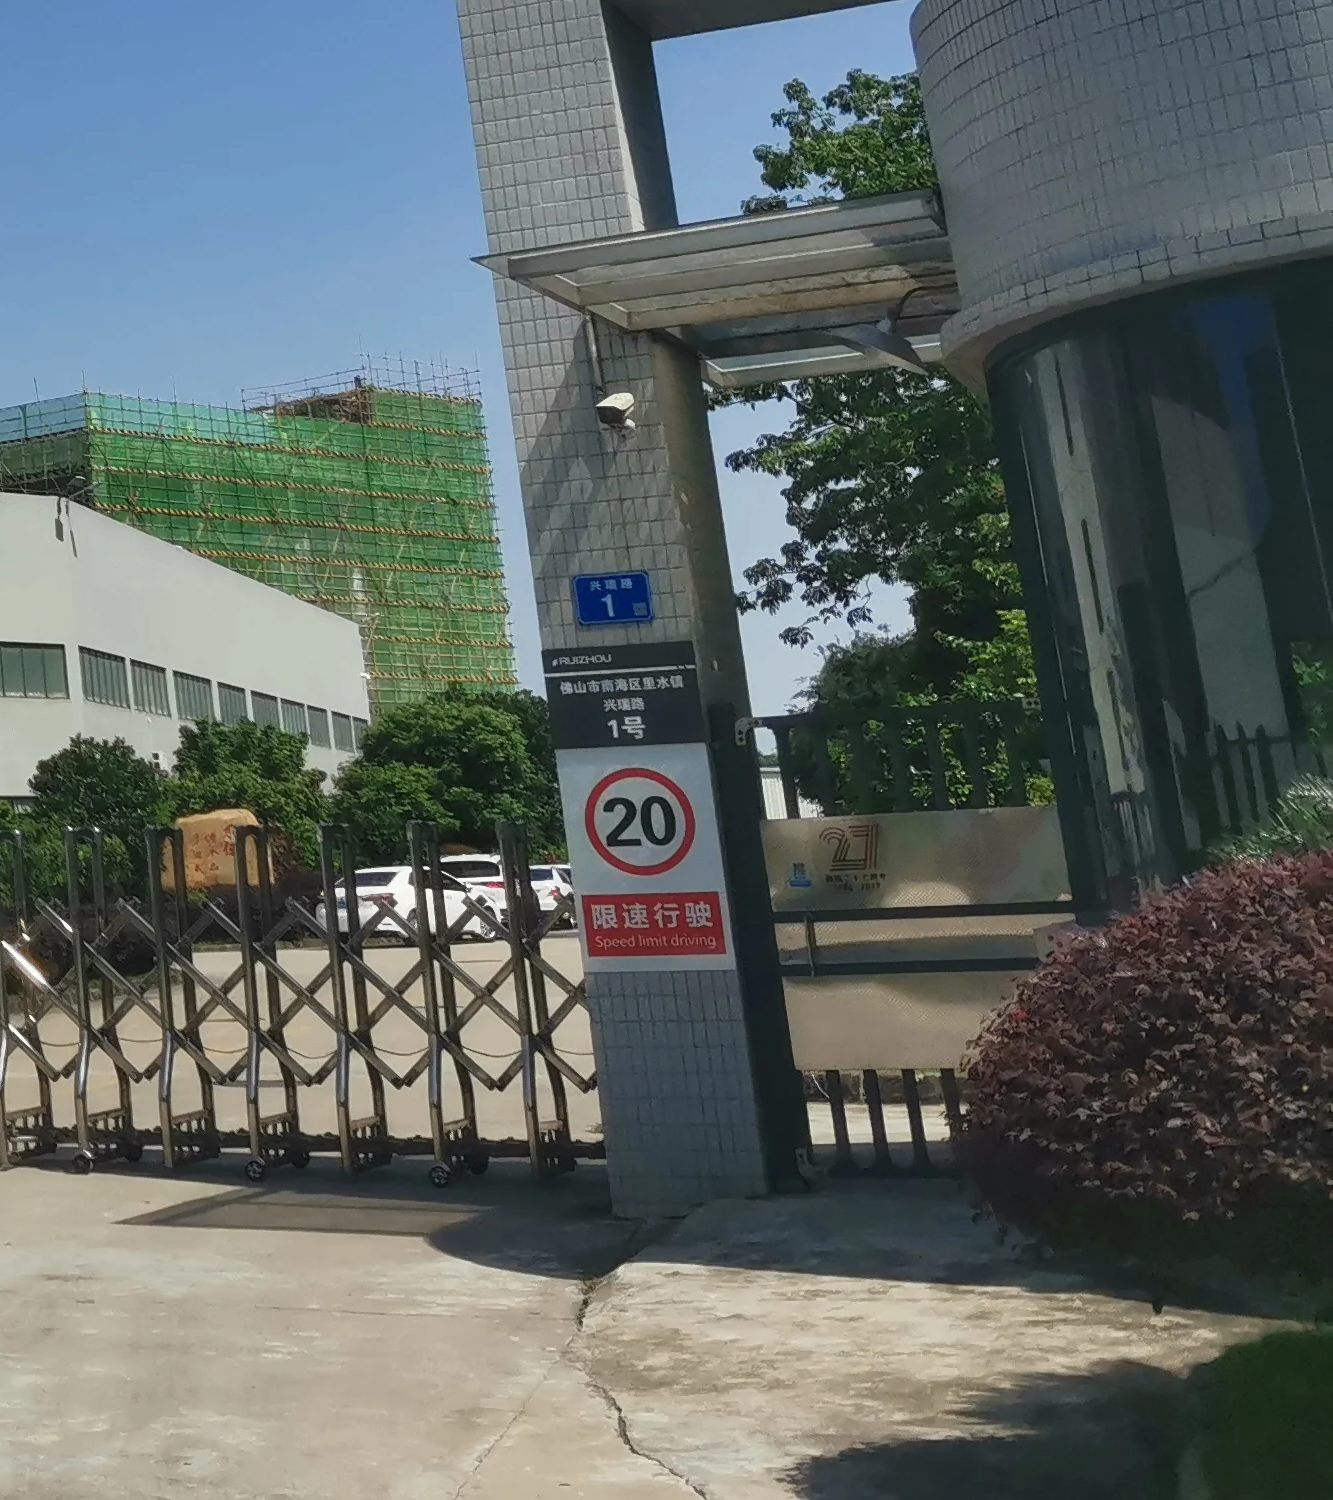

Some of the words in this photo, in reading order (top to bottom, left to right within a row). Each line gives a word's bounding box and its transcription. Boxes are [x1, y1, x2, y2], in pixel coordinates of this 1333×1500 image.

[600, 593, 615, 618] 1
[558, 653, 612, 666] RUIZHOU
[607, 715, 647, 740] 1号
[602, 795, 677, 847] 20
[590, 900, 714, 930] 限速行驶
[594, 934, 636, 950] Speed
[638, 934, 668, 948] limit
[670, 933, 717, 949] driving
